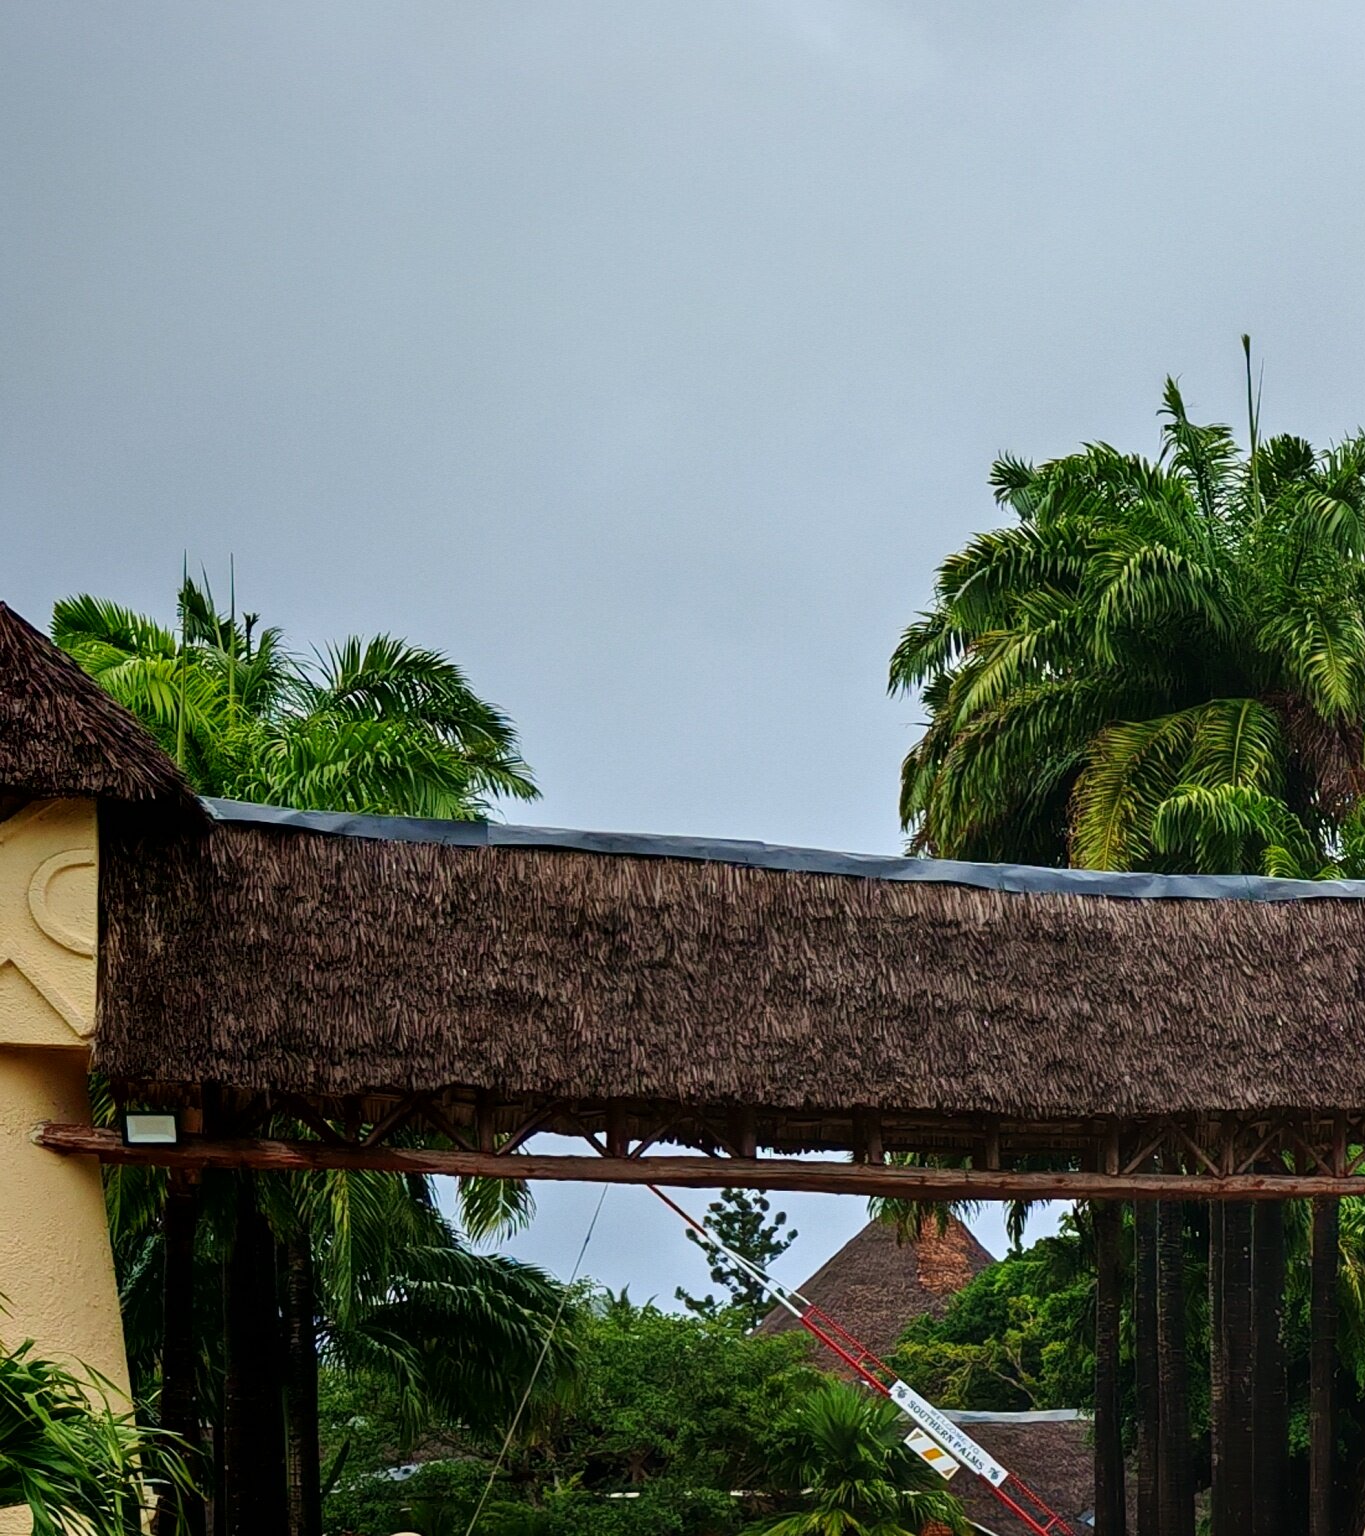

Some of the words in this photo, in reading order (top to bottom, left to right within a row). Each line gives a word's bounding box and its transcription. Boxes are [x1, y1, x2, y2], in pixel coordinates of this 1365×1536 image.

[907, 1400, 955, 1444] SOUTHERN
[953, 1441, 985, 1470] PALMS
[929, 1409, 967, 1444] WELCOME
[968, 1442, 980, 1455] TO
